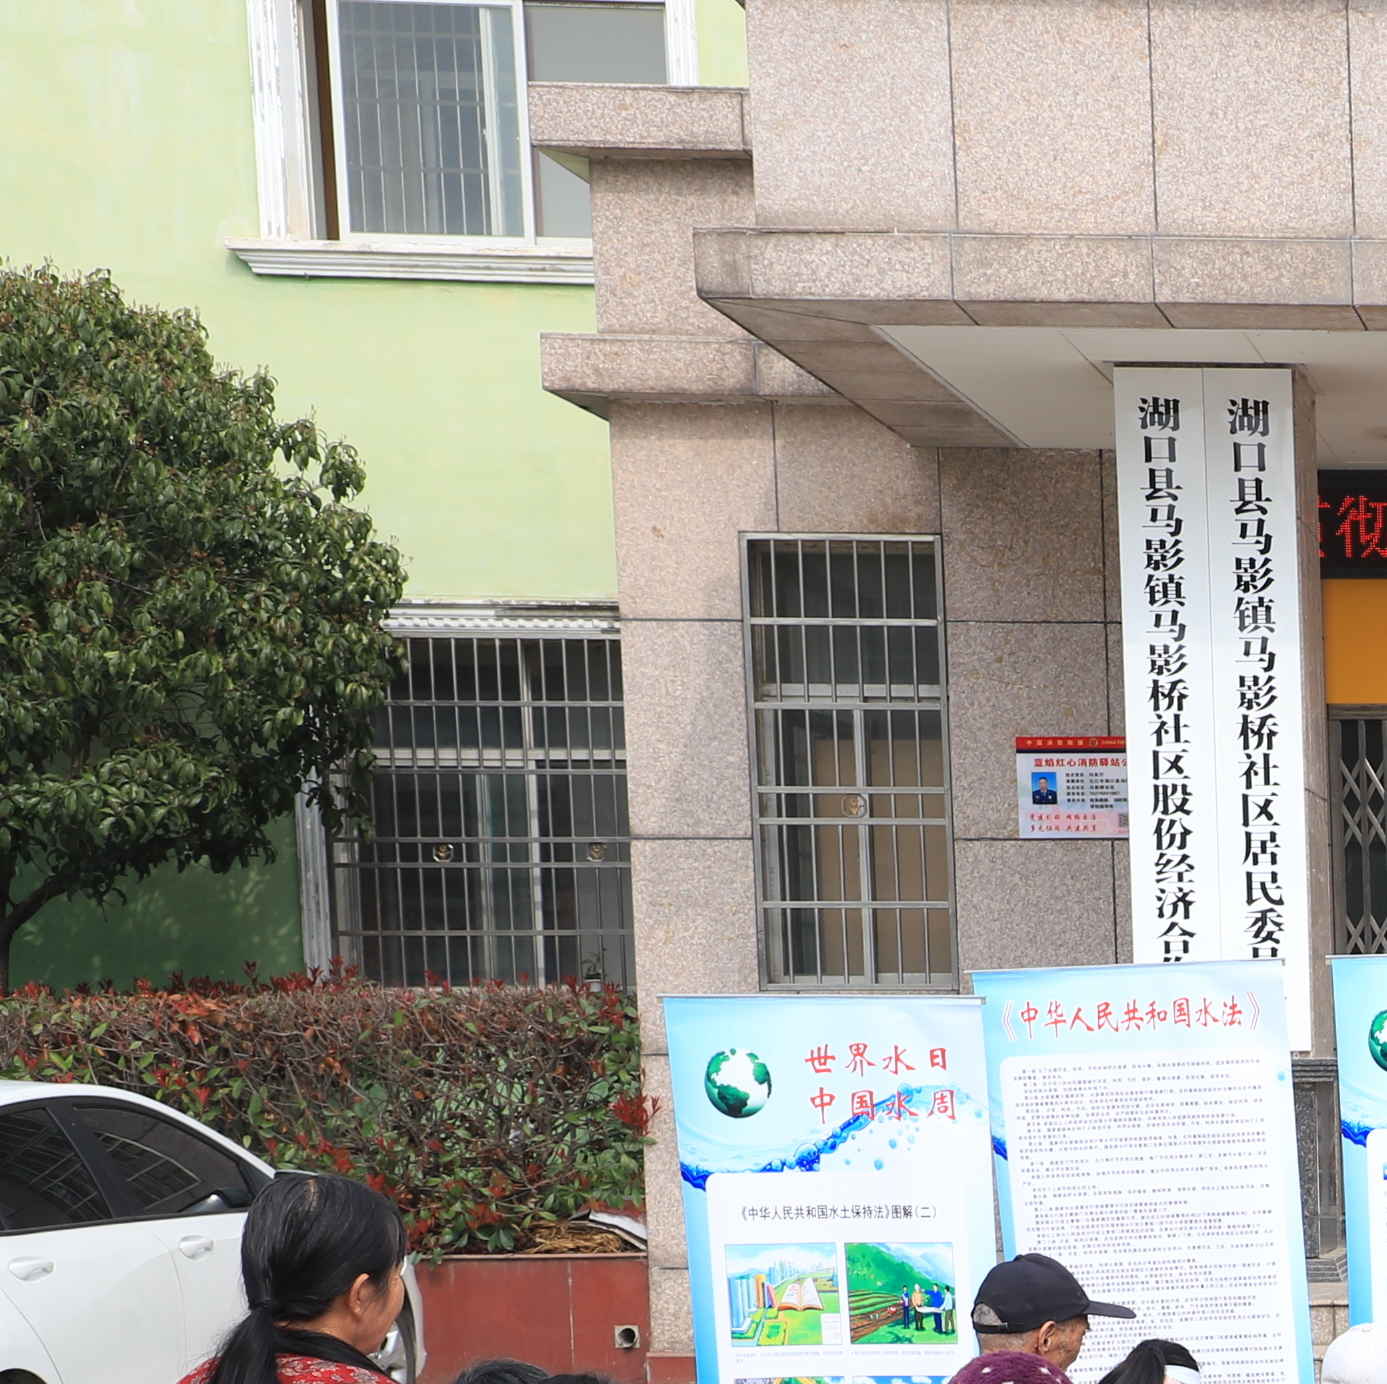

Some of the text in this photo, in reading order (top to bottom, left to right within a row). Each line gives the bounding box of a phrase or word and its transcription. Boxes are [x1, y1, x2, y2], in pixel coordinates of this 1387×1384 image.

[1138, 397, 1197, 962] 湖口县马影镇马影桥社区股份经济合
[1002, 990, 1261, 1041] 《中华人民共和国水法》
[804, 1042, 947, 1078] 世界水日
[809, 1086, 956, 1125] 中国水周
